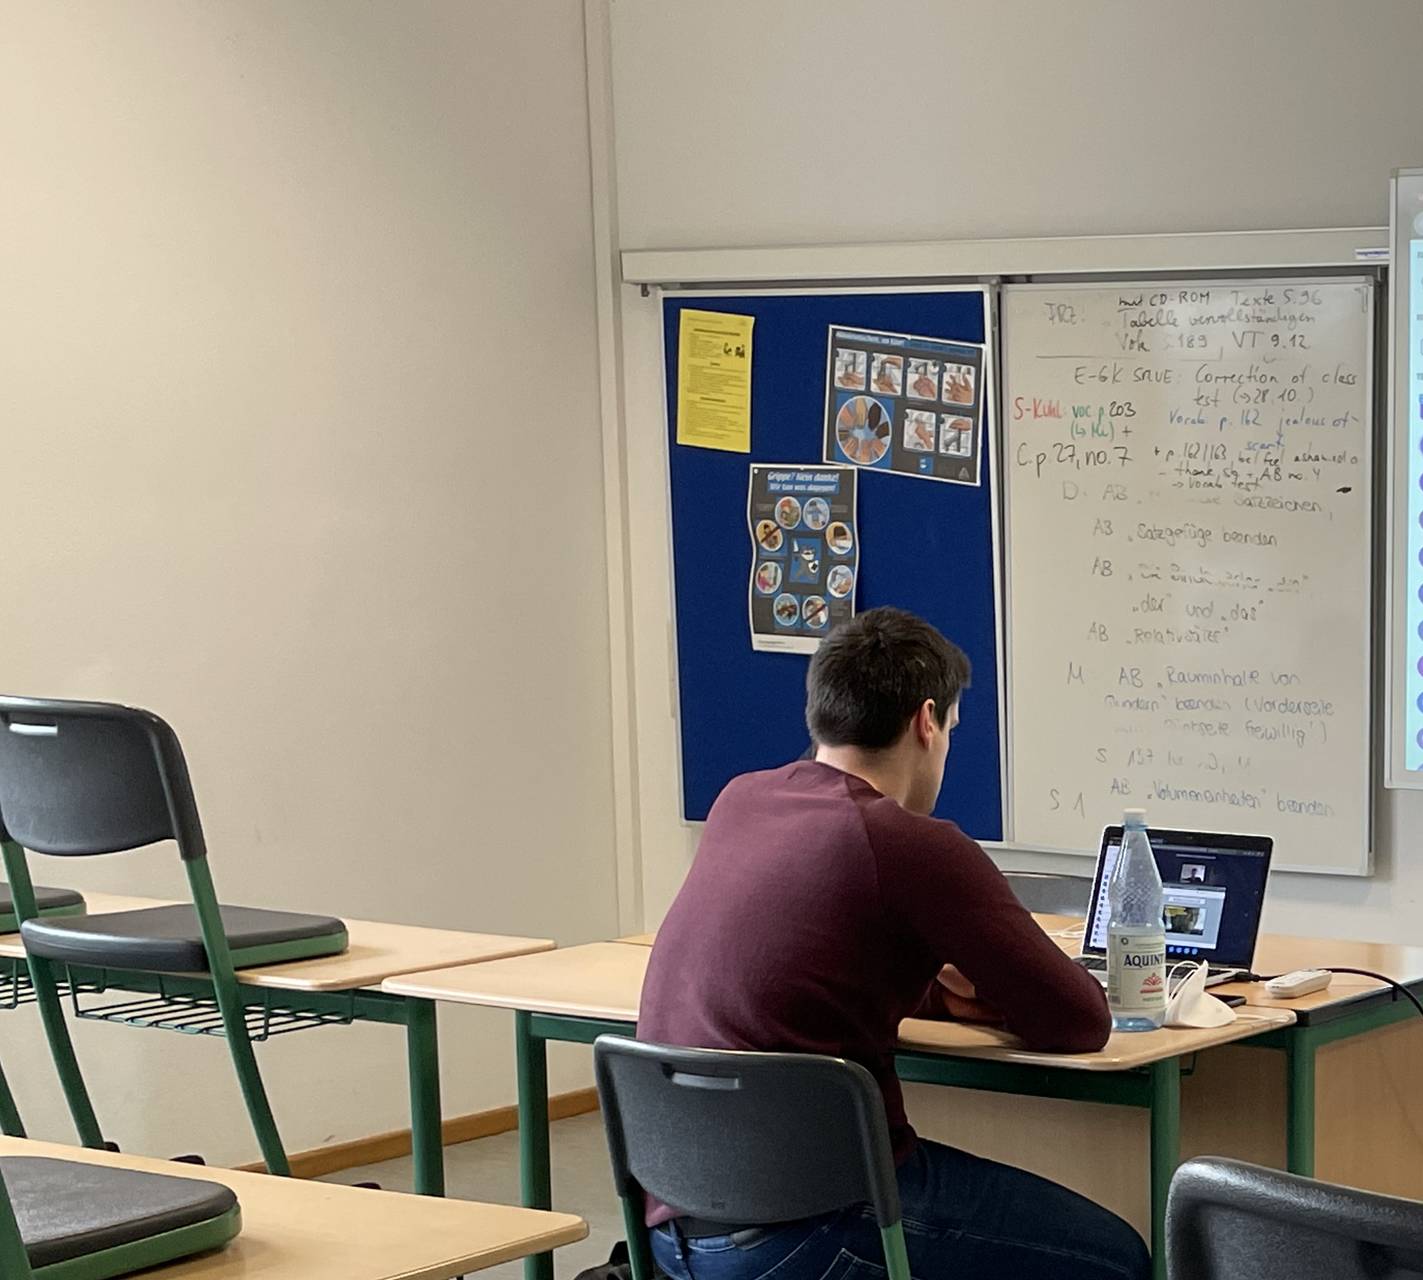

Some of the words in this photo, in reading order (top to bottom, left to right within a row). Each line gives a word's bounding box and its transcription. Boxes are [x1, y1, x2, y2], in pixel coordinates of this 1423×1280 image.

[1149, 290, 1211, 306] CD-ROM
[1117, 307, 1179, 329] Tabelle
[1195, 362, 1280, 385] Correction
[1290, 363, 1312, 384] of
[1321, 361, 1358, 385] class
[1108, 400, 1137, 418] 203
[1113, 446, 1135, 467] 7
[1186, 600, 1215, 620] und
[1066, 661, 1086, 686] M
[1118, 666, 1145, 689] AB
